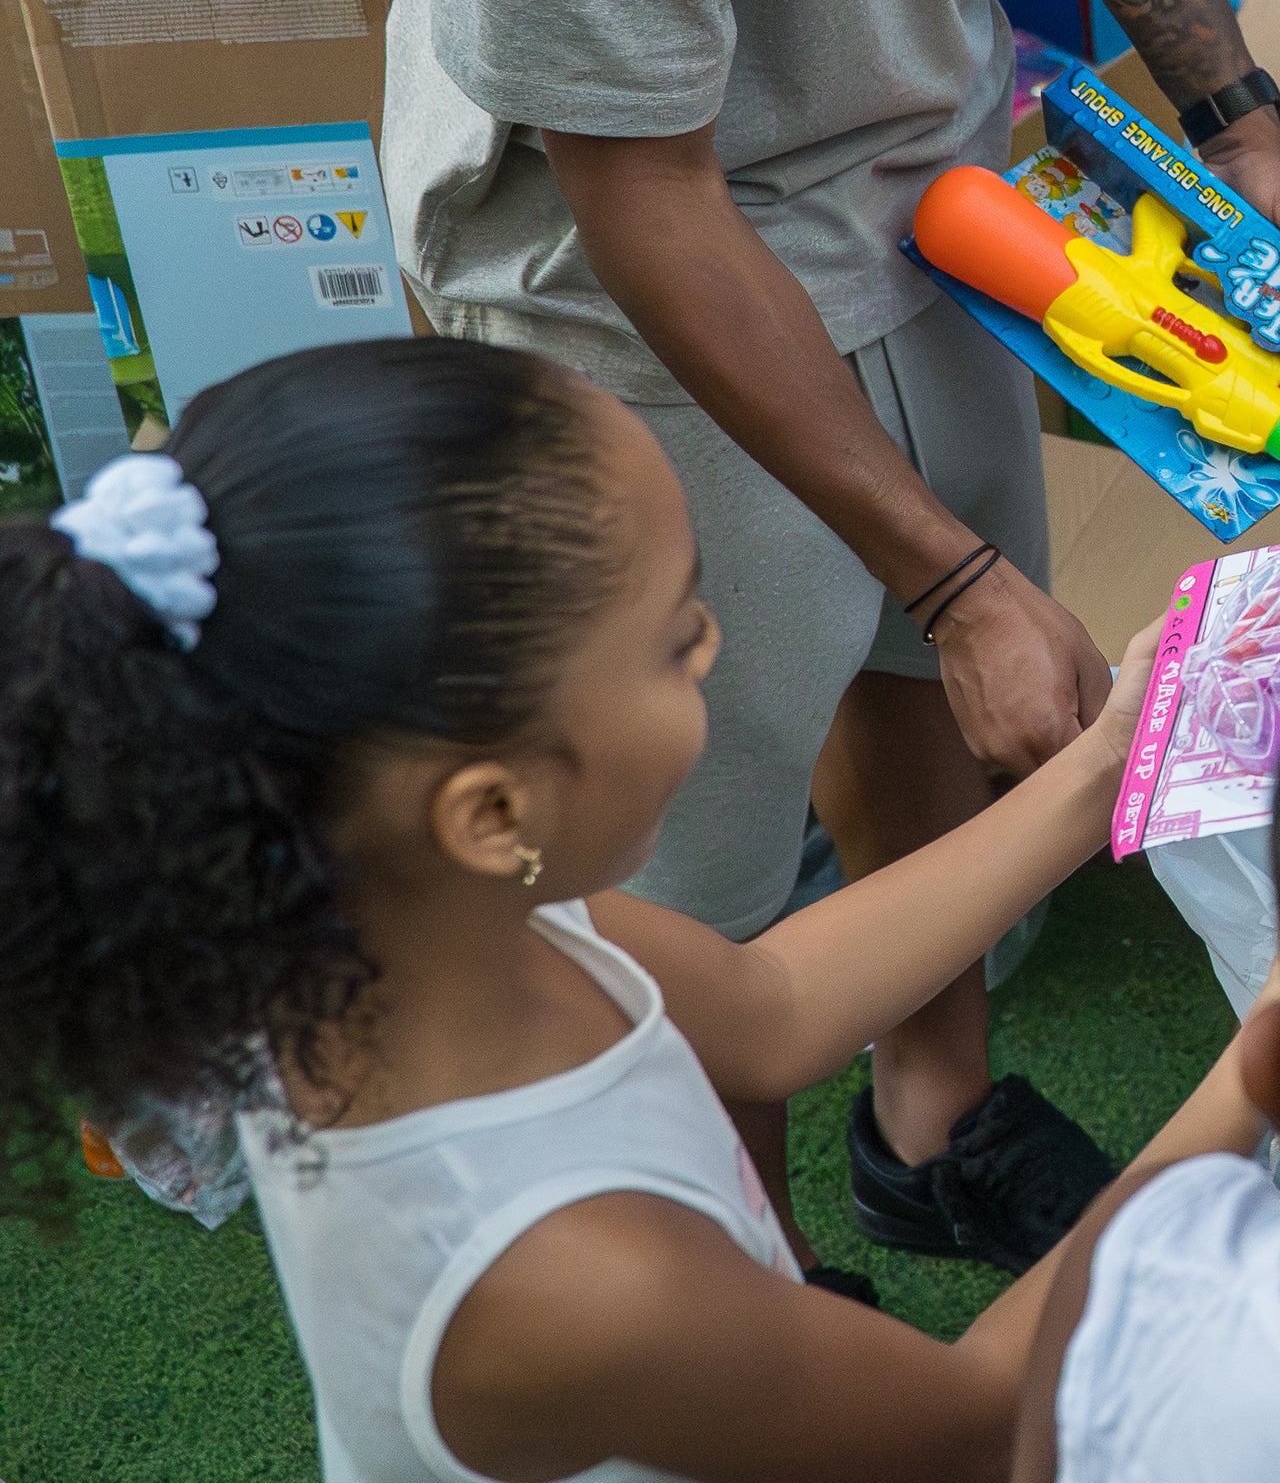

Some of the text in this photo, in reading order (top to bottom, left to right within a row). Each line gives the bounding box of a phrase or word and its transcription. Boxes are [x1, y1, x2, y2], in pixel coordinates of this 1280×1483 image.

[1071, 82, 1244, 229] LONG-DISTANCE SPOUT
[1118, 660, 1182, 846] MAKE UP SET
